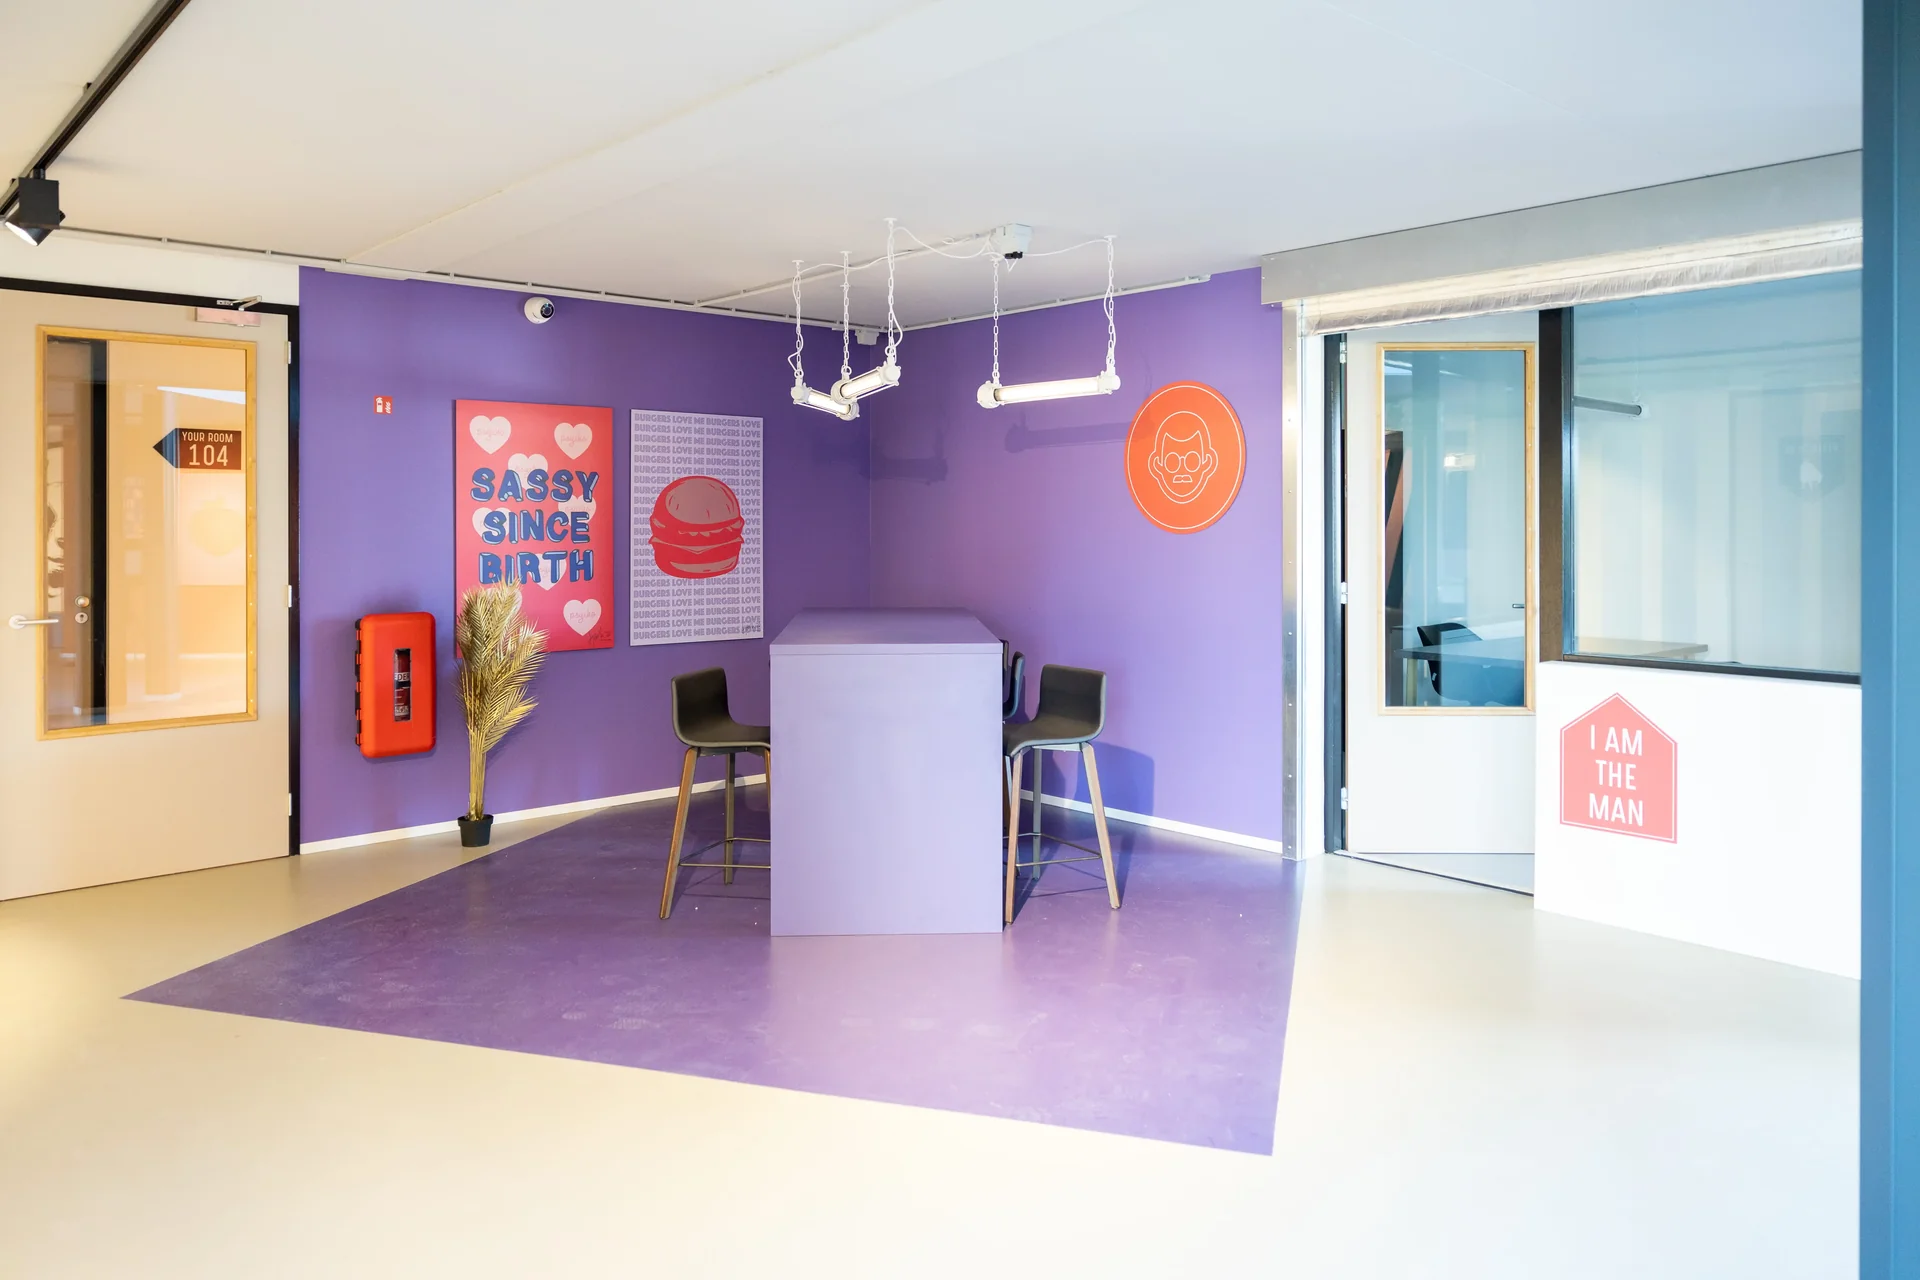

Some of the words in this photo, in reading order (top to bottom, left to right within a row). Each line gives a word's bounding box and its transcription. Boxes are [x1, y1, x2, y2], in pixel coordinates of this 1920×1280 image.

[634, 413, 670, 423] BURGERS
[672, 416, 692, 424] LOVE
[694, 417, 704, 425] ME
[706, 418, 740, 427] BURGERS
[742, 420, 760, 428] LOVE
[182, 431, 205, 442] YOUR
[208, 432, 233, 443] ROOM
[634, 423, 670, 433] BURGERS
[672, 426, 692, 434] LOVE
[694, 427, 704, 435] ME
[706, 428, 740, 437] BURGERS
[742, 430, 760, 438] LOVE
[634, 434, 670, 443] BURGERS
[672, 436, 692, 445] LOVE
[694, 437, 704, 445] ME
[706, 438, 740, 447] BURGERS
[742, 440, 760, 448] LOVE
[189, 444, 228, 467] 104
[634, 444, 670, 454] BURGERS
[672, 446, 692, 455] LOVE
[694, 447, 704, 455] ME
[706, 448, 740, 457] BURGERS
[742, 450, 760, 458] LOVE
[634, 455, 670, 464] BURGERS
[672, 456, 692, 465] LOVE
[694, 457, 704, 465] ME
[706, 458, 740, 467] BURGERS
[742, 459, 760, 467] LOVE
[634, 465, 670, 474] BURGERS
[672, 466, 692, 475] LOVE
[694, 467, 704, 475] ME
[706, 468, 740, 476] BURGERS
[742, 469, 760, 477] LOVE
[471, 468, 599, 503] SASSY
[742, 479, 760, 487] LOVE
[634, 486, 663, 494] BURGE
[634, 496, 656, 504] BURG
[742, 508, 760, 516] LOVE
[482, 509, 590, 545] SINCE
[479, 549, 594, 586] BIRTH
[634, 558, 656, 566] BURG
[742, 557, 760, 565] LOVE
[634, 578, 670, 587] BURGERS
[672, 578, 692, 586] LOVE
[706, 577, 740, 585] BURGERS
[634, 589, 670, 597] BURGERS
[672, 588, 692, 596] LOVE
[694, 588, 704, 596] ME
[706, 587, 740, 595] BURGERS
[742, 586, 760, 594] LOVE
[634, 599, 670, 608] BURGERS
[672, 598, 692, 606] LOVE
[694, 598, 704, 606] ME
[706, 597, 740, 605] BURGERS
[742, 596, 760, 604] LOVE
[634, 609, 670, 618] BURGERS
[672, 608, 692, 617] LOVE
[694, 608, 704, 616] ME
[706, 607, 740, 615] BURGERS
[742, 606, 760, 614] LOVE
[634, 619, 670, 629] BURGERS
[672, 618, 692, 627] LOVE
[694, 618, 704, 626] ME
[706, 616, 740, 625] BURGERS
[634, 629, 670, 639] BURGERS
[672, 628, 692, 637] LOVE
[694, 628, 704, 636] ME
[706, 626, 740, 635] BURGERS
[1591, 724, 1596, 750] I
[1605, 726, 1642, 756] AM
[1595, 759, 1636, 790] THE
[1589, 793, 1643, 827] MAN
